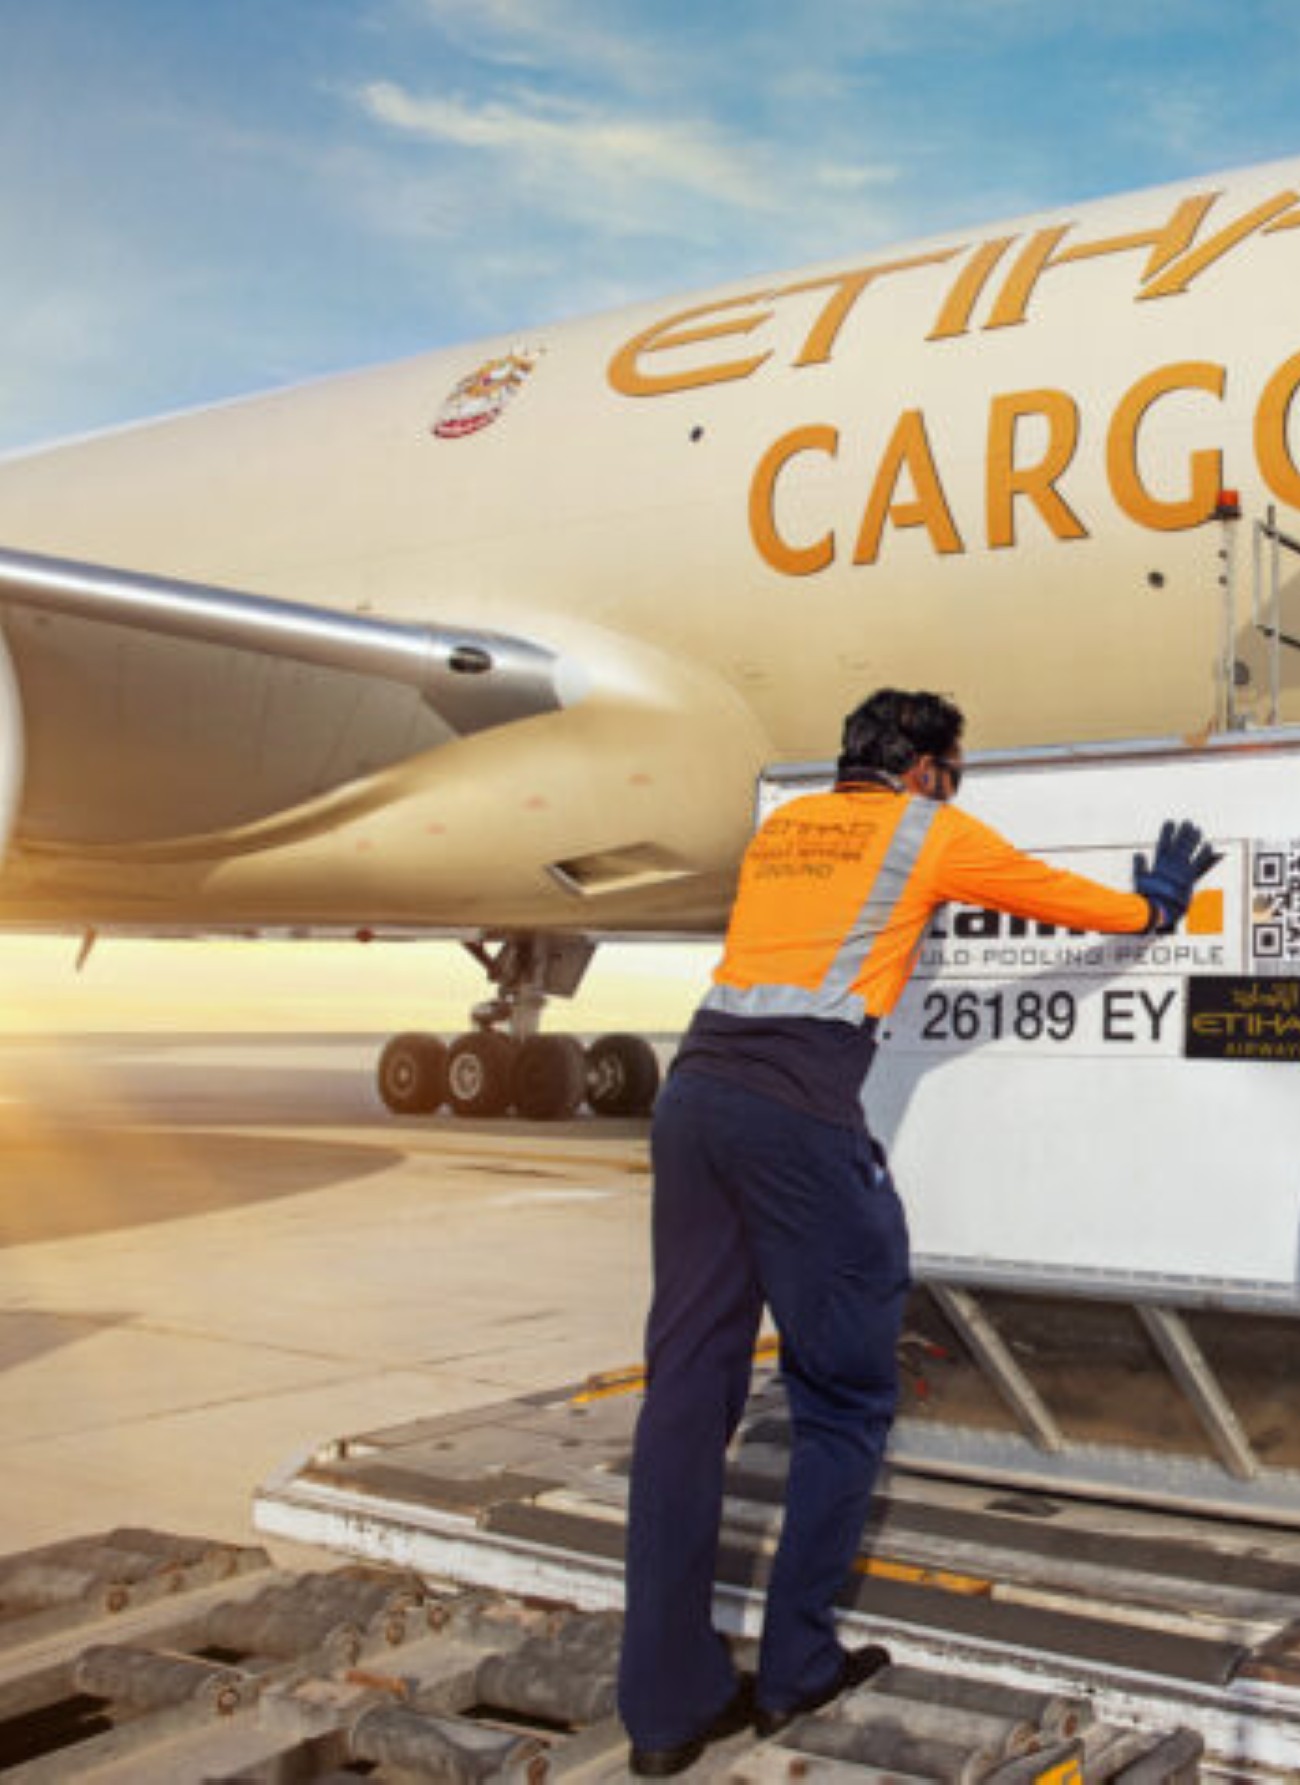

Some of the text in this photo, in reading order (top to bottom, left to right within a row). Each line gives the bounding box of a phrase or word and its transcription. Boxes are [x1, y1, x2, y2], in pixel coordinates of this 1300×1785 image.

[982, 945, 1104, 967] POOLING
[1114, 945, 1224, 966] PEOPLE
[922, 990, 1175, 1041] 26189 EY
